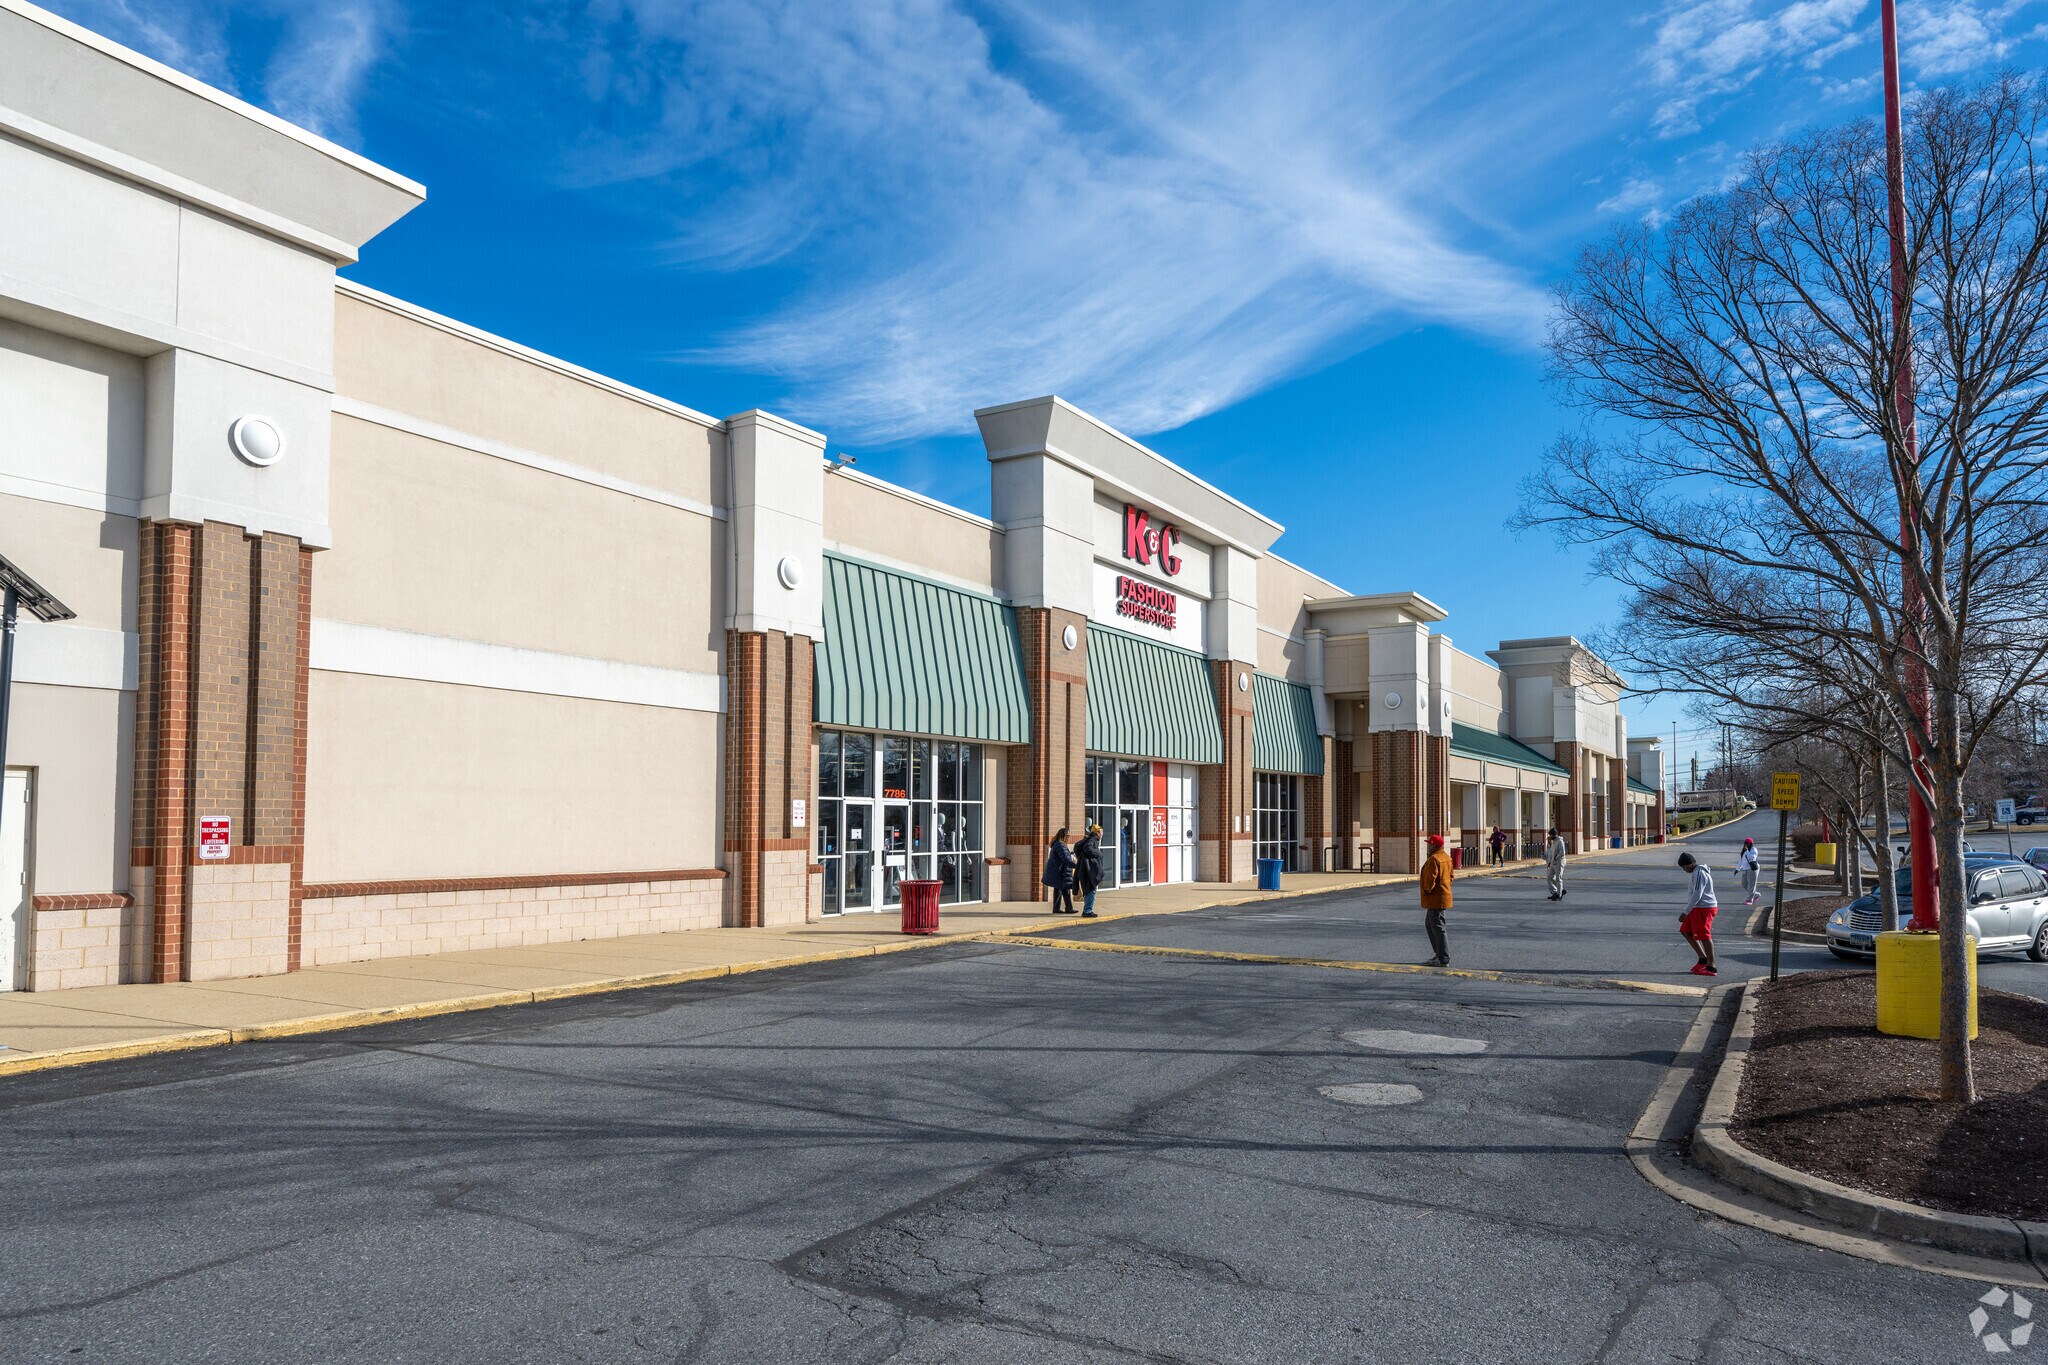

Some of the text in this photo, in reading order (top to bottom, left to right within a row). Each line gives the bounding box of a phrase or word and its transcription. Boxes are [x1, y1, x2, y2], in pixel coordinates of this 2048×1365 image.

[1122, 504, 1182, 576] K&G
[1116, 576, 1176, 613] FASHION
[1117, 600, 1176, 629] SUPERSTORE
[884, 788, 906, 798] 7786
